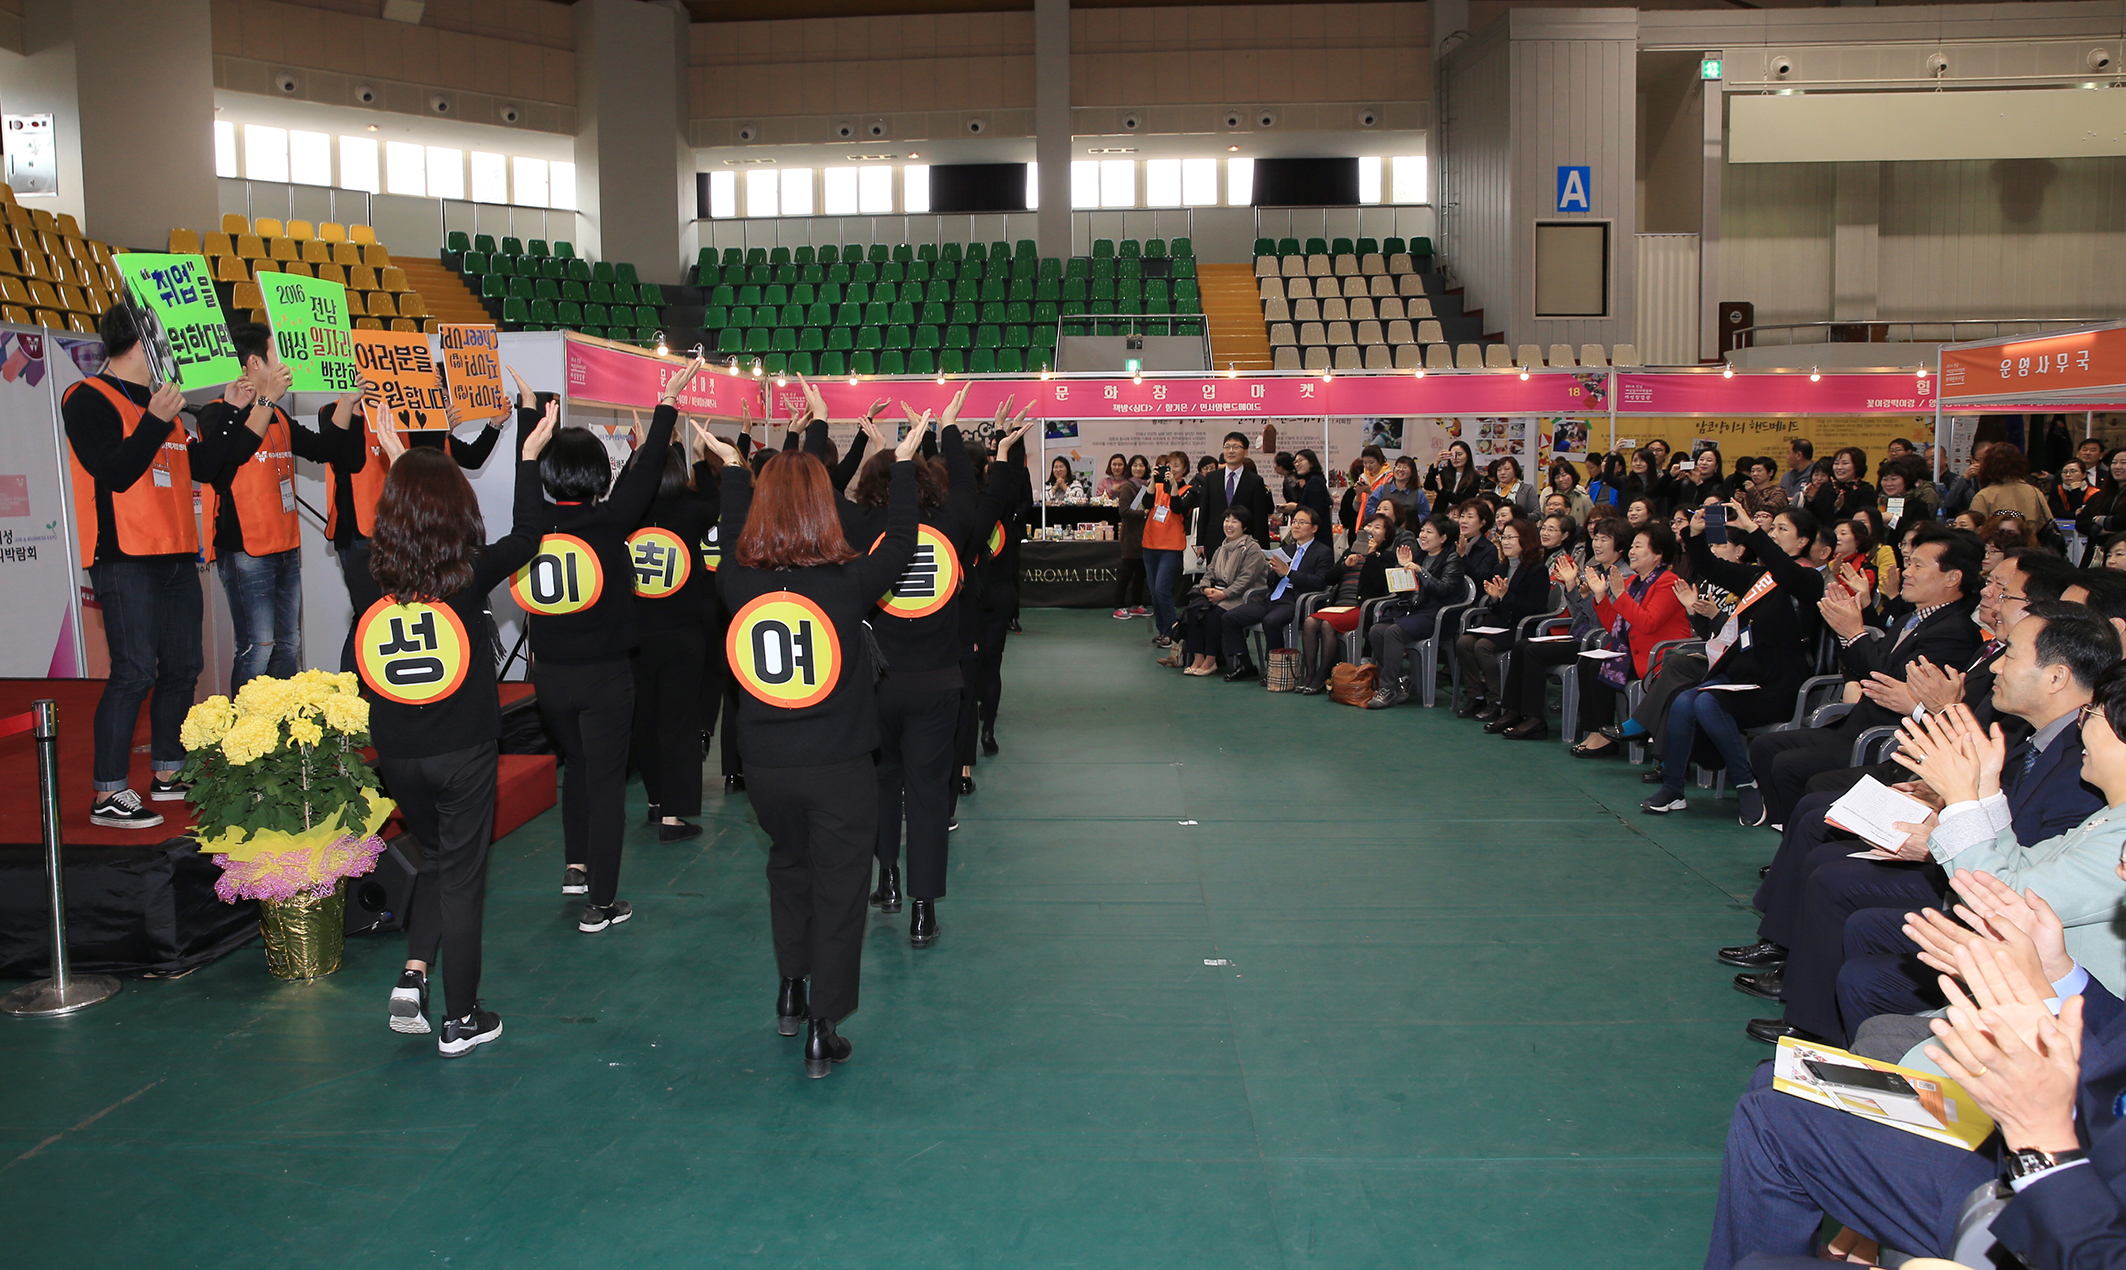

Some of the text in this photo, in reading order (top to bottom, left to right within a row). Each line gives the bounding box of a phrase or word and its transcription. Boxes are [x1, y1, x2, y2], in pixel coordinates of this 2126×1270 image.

[1559, 170, 1588, 208] A
[276, 284, 338, 326] 2016 전남
[166, 322, 238, 365] 원한다면
[277, 326, 352, 361] 여성 일자리
[354, 342, 433, 376] 여러분을
[1999, 350, 2090, 379] 운영사무국
[364, 379, 446, 410] 응원합니다
[1568, 387, 1581, 397] 18
[1866, 399, 1915, 408] 꽃이랑떡이랑
[1695, 420, 1745, 434] 암코양이의
[1749, 420, 1799, 434] 핸드메이드
[0, 529, 12, 545] 성
[529, 551, 581, 605] 이
[635, 540, 678, 589] 취
[1024, 568, 1118, 582] AROMA EUN
[378, 611, 445, 686] 성
[749, 619, 816, 686] 여
